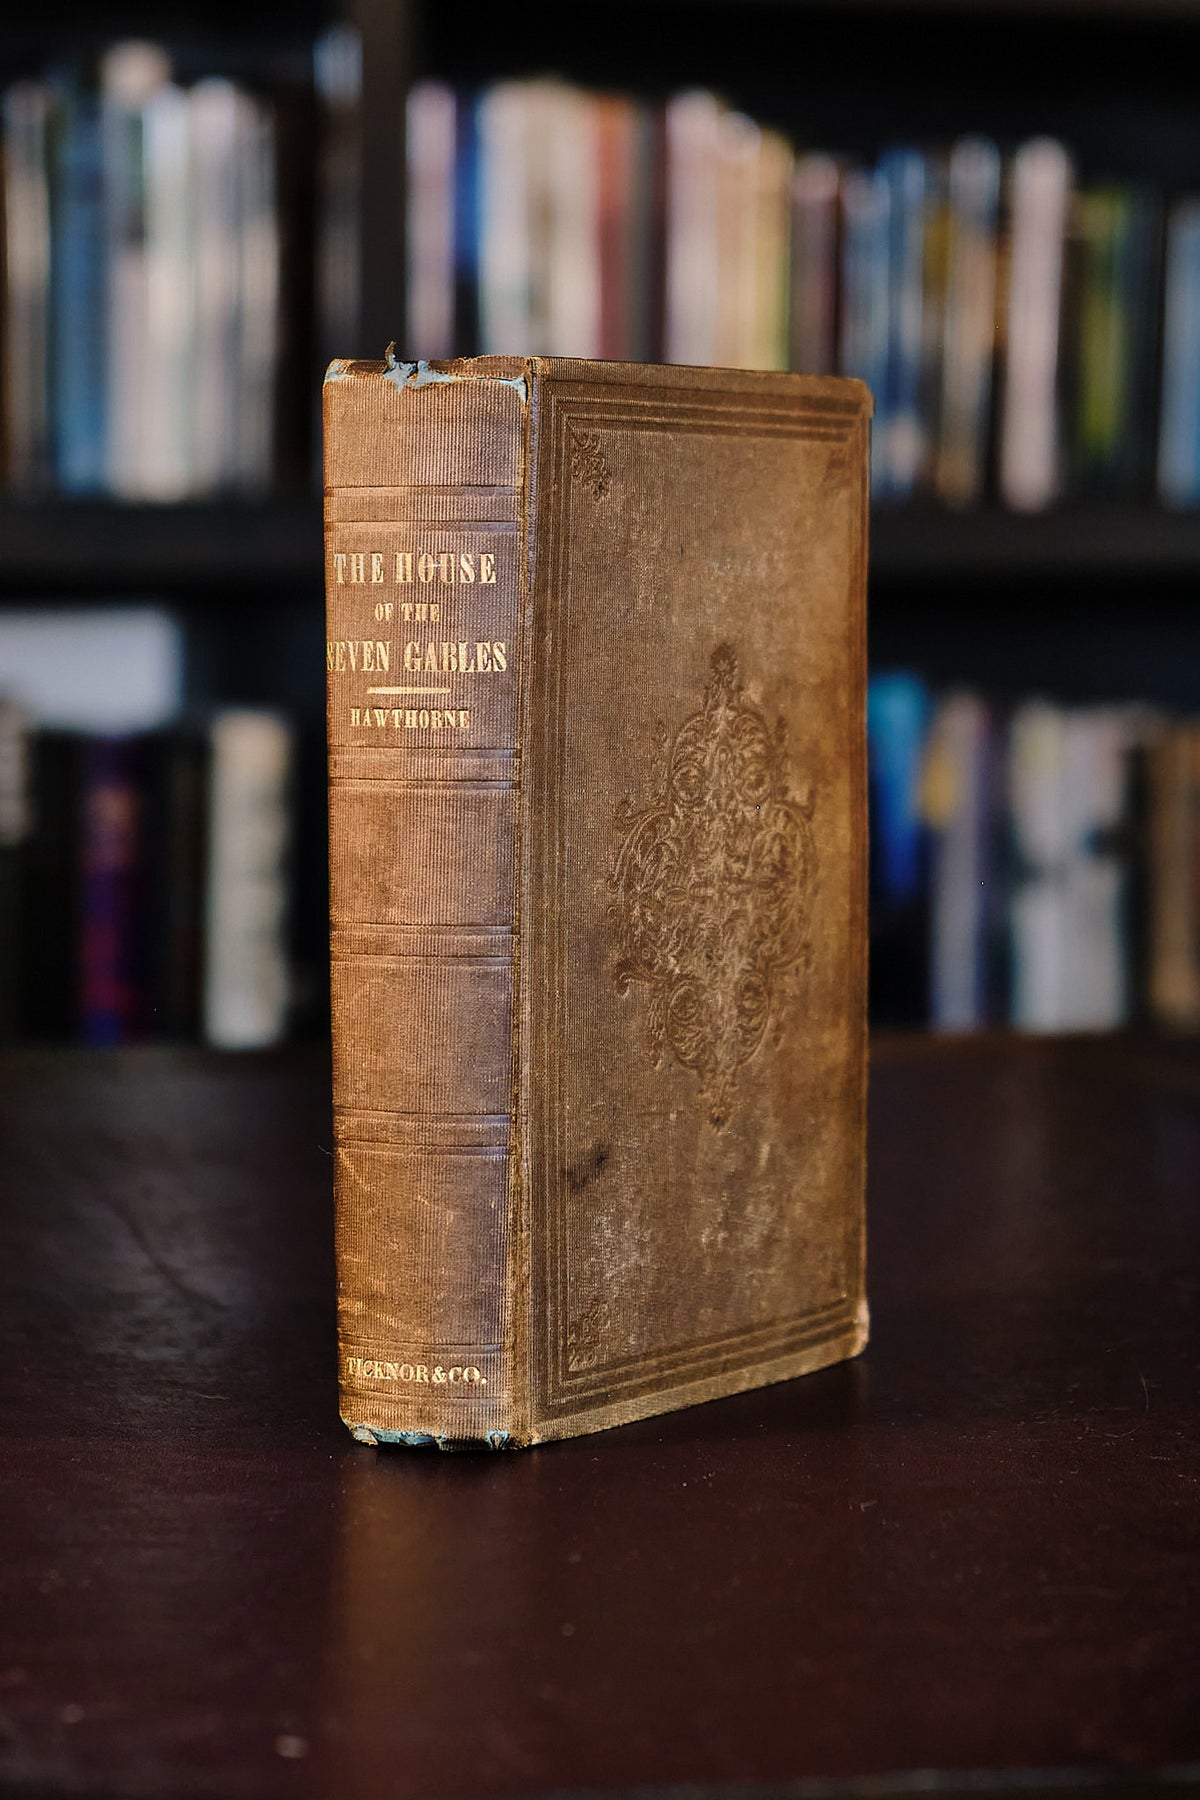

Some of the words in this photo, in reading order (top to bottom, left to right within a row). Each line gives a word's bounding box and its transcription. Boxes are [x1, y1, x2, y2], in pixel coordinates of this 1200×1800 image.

[334, 553, 384, 583] THE
[394, 552, 497, 584] HOUSE
[374, 602, 394, 621] OF
[401, 602, 440, 622] THE
[326, 640, 391, 672] SEVEN
[404, 641, 507, 673] GABLES
[350, 708, 470, 728] HAWTHORNE
